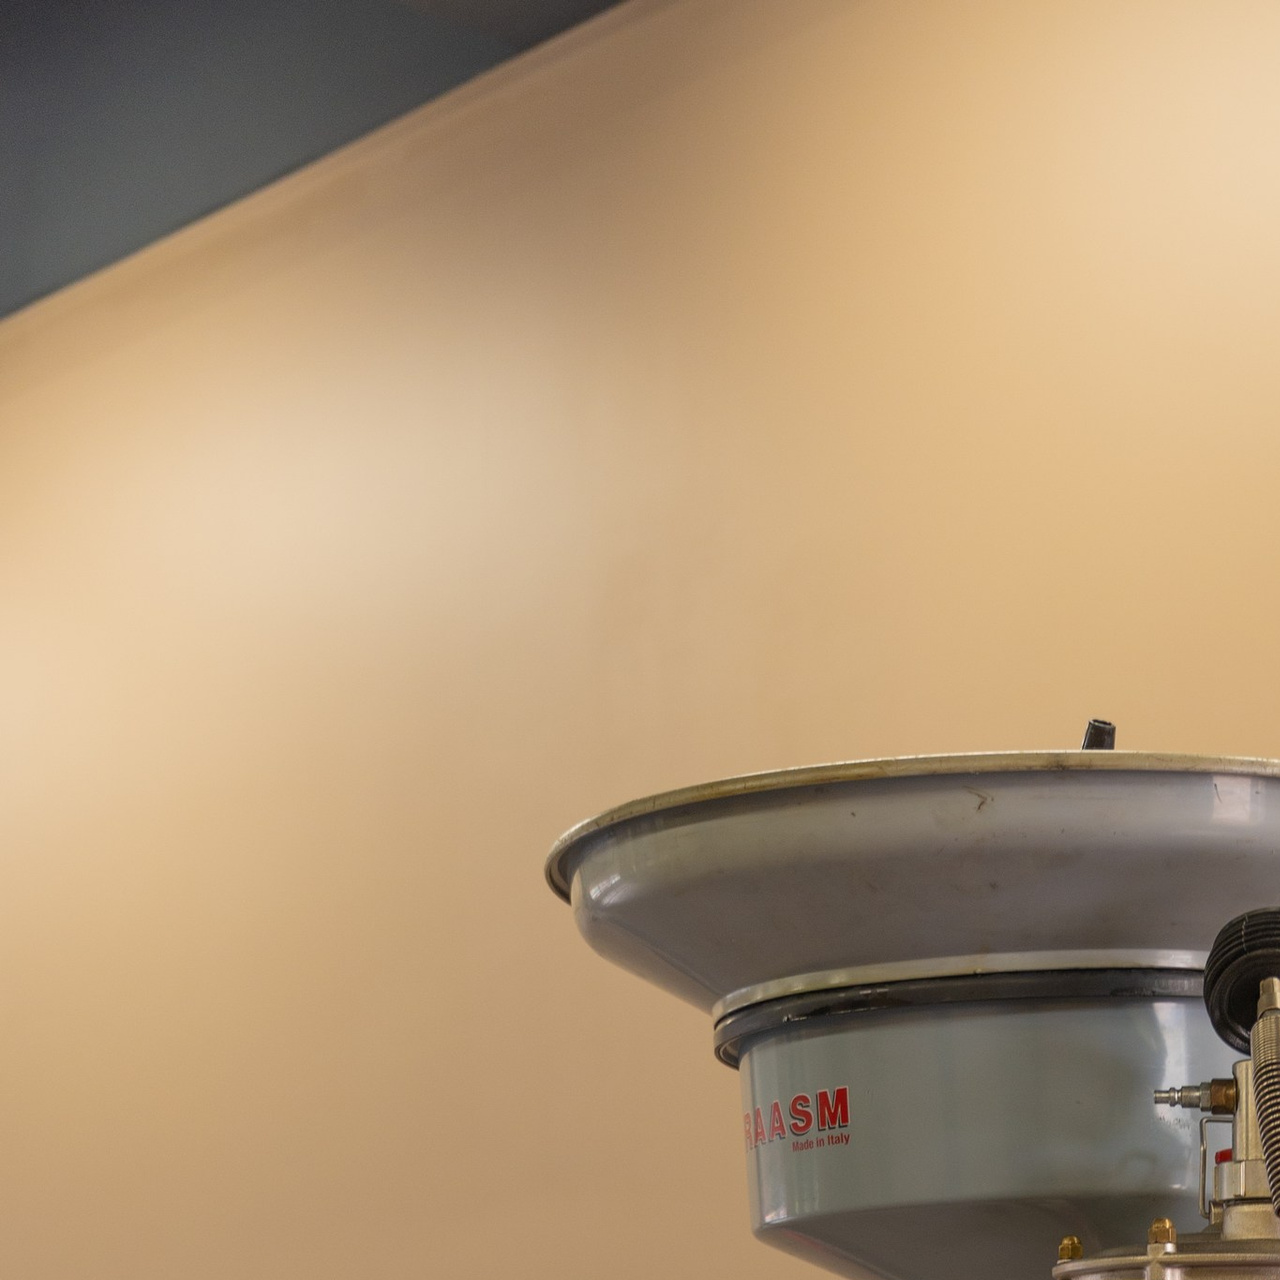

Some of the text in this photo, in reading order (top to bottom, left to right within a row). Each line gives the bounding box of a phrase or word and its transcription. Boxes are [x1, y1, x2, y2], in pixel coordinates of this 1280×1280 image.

[792, 1133, 850, 1152] Made in Italy
